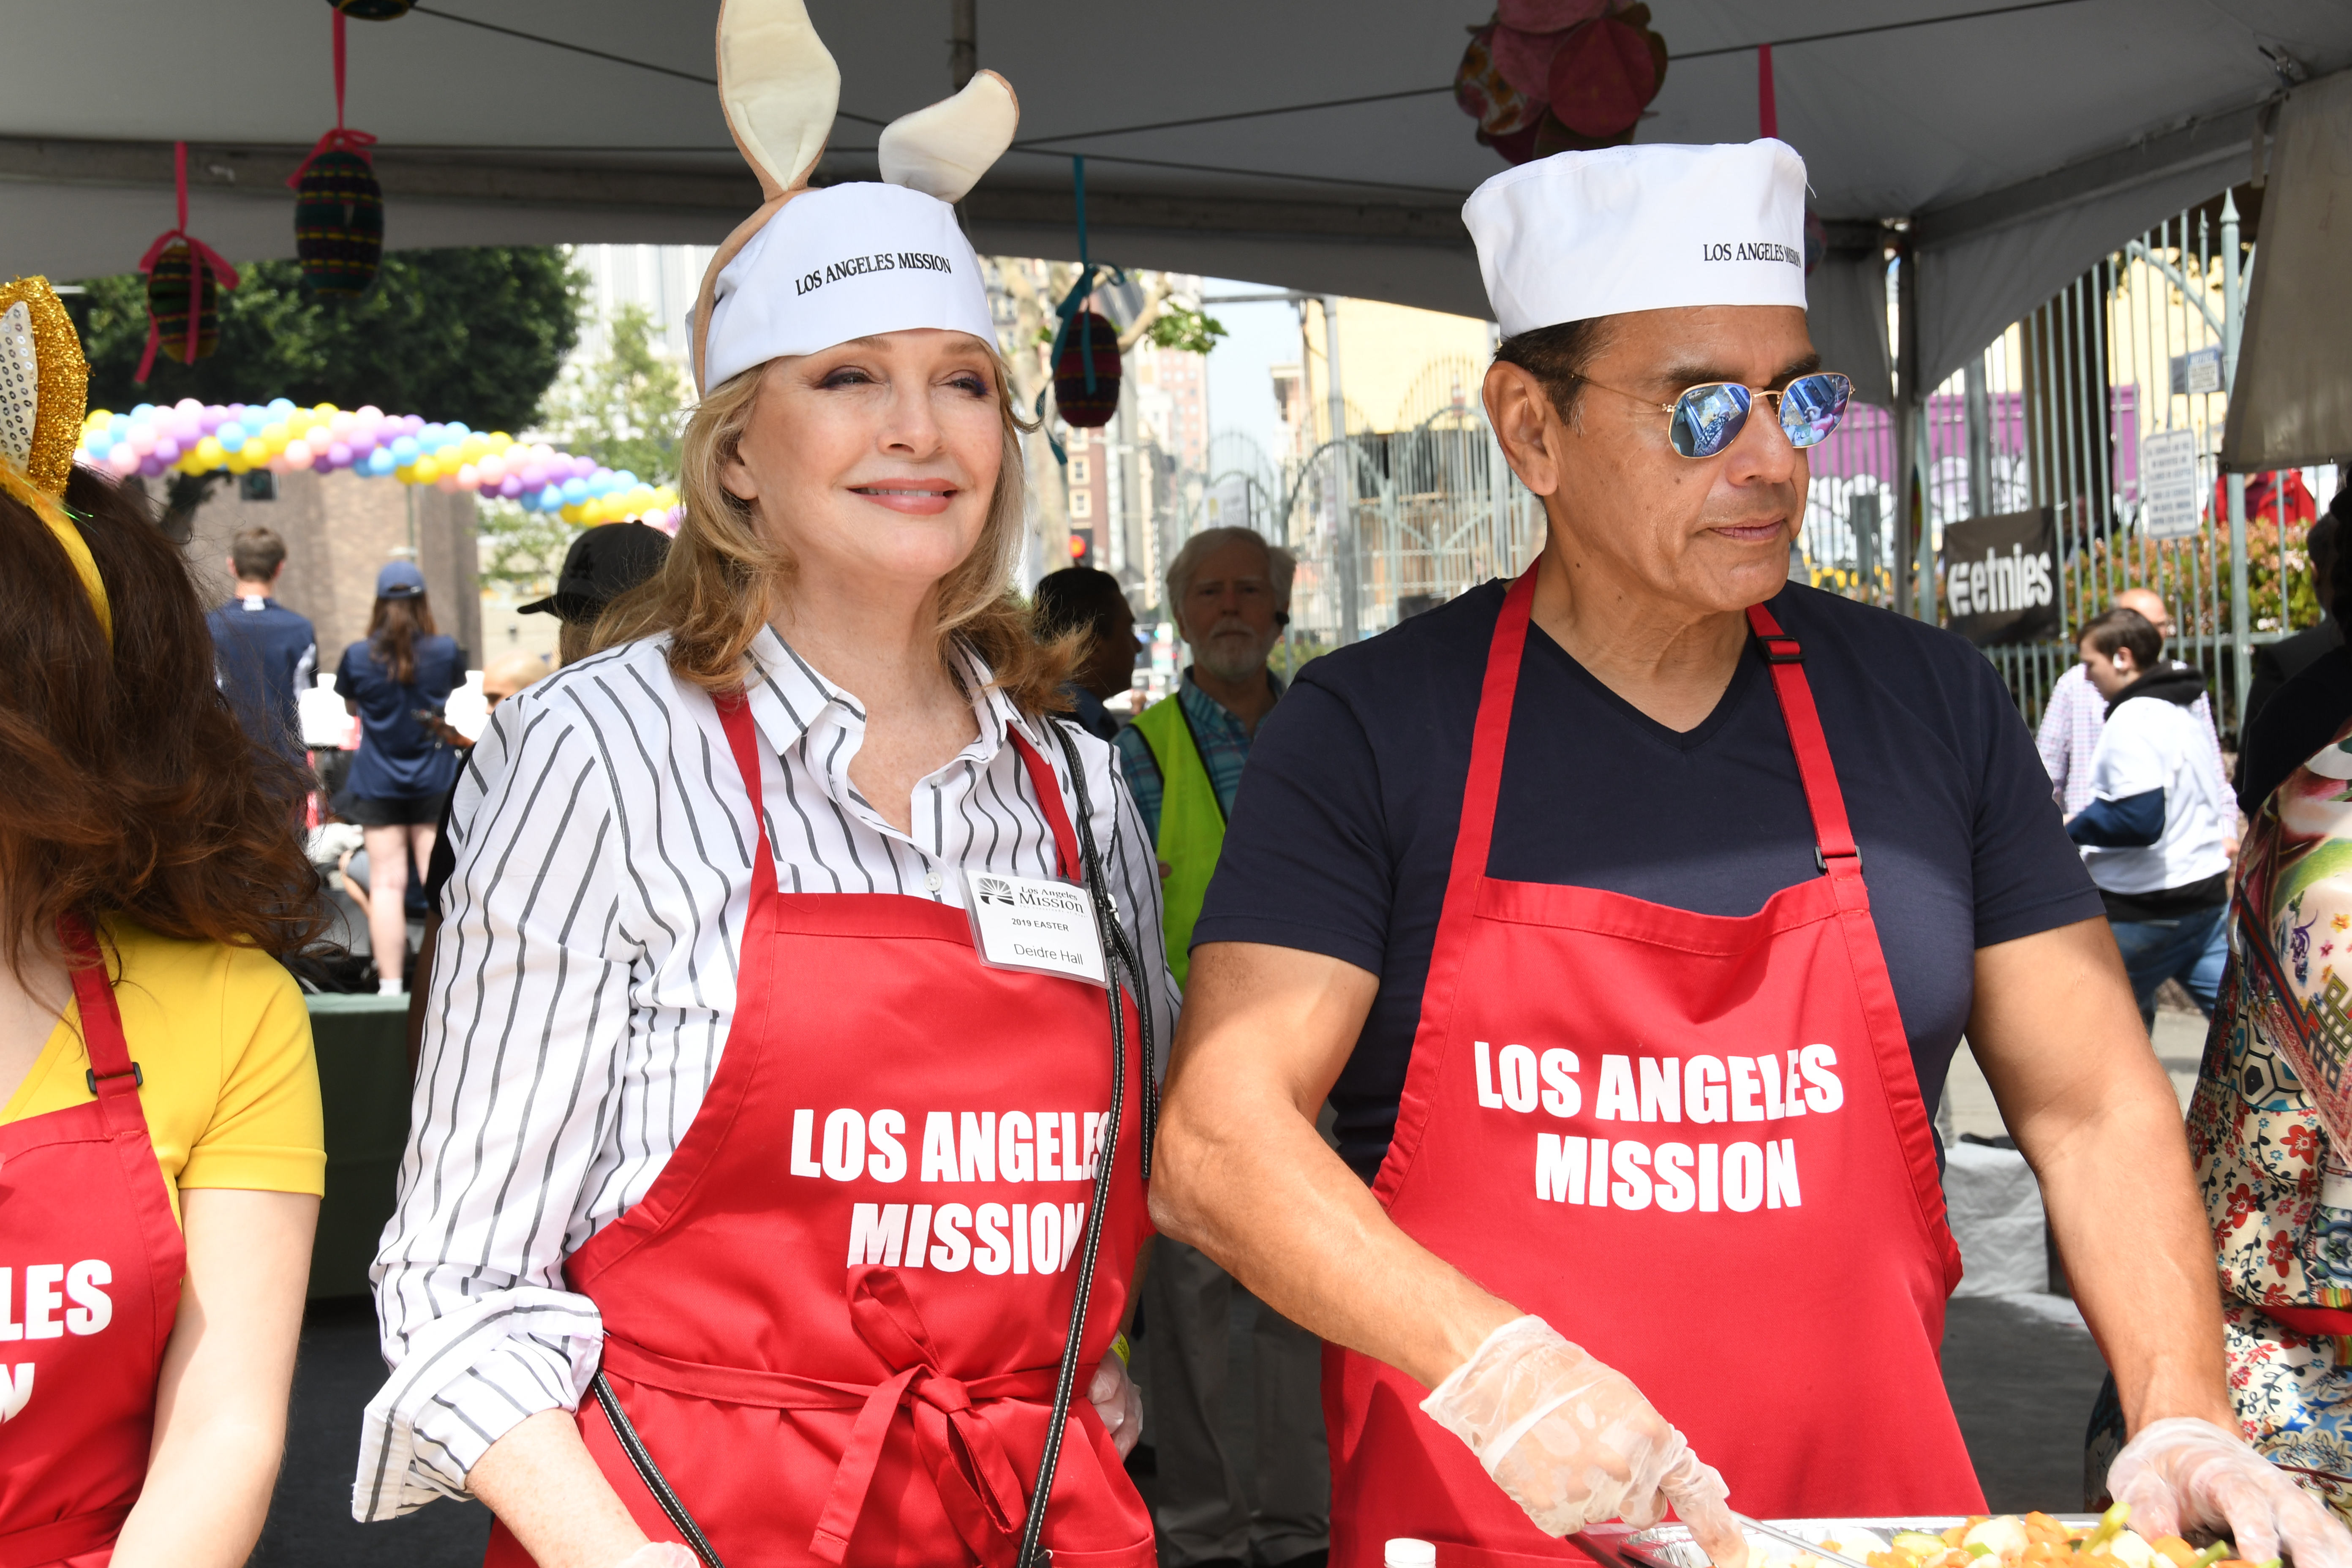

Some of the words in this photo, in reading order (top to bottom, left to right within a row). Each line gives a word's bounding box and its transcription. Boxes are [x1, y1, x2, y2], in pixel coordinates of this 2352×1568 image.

[1703, 243, 1732, 261] LOS
[1736, 242, 1784, 261] ANGELES
[795, 270, 822, 296] LOS
[825, 253, 895, 285] ANGELES
[897, 252, 952, 274] MISSION
[1021, 886, 1039, 895] Los
[1041, 889, 1078, 901] Angeles
[1011, 917, 1032, 927] 2019
[1034, 920, 1069, 932] EASTER
[1014, 943, 1057, 960] Deidre
[1061, 949, 1083, 965] Hall
[1474, 1040, 1582, 1118] LOS
[1595, 1043, 1844, 1124] ANGELES
[790, 1108, 908, 1182] LOS
[920, 1111, 1110, 1183] ANGELES
[1535, 1132, 1802, 1213] MISSION
[847, 1202, 1085, 1276] MISSION
